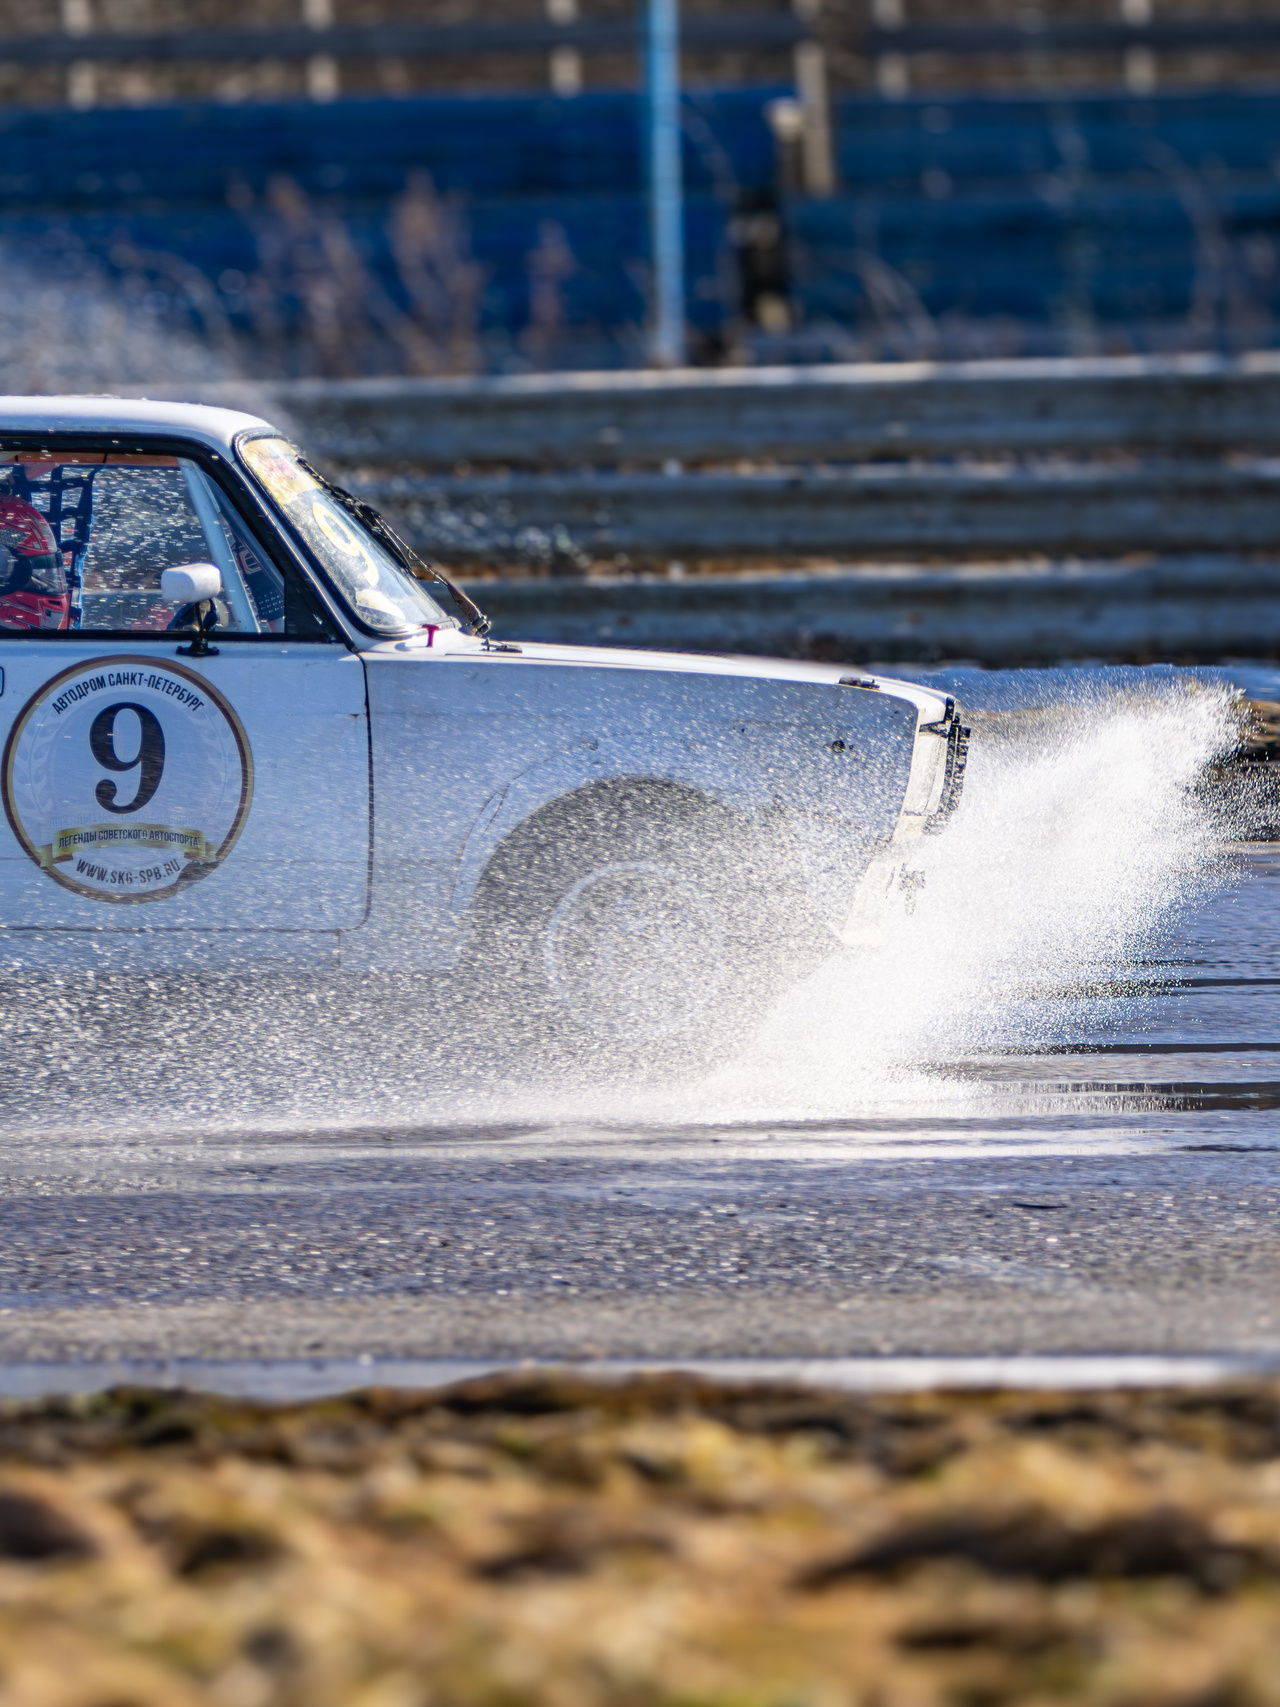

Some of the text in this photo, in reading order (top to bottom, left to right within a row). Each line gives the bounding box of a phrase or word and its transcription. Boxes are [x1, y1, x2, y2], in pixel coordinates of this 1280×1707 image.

[51, 671, 204, 715] АВТОДРОМ САНКТ-ПЕТЕРБУРГ
[89, 701, 166, 815] 9
[58, 829, 199, 849] ЛЕГЕНДЫ СОВЕТСКОГО АВТОСПОРТА
[76, 858, 181, 885] WWW.SKG-SPB.RU
